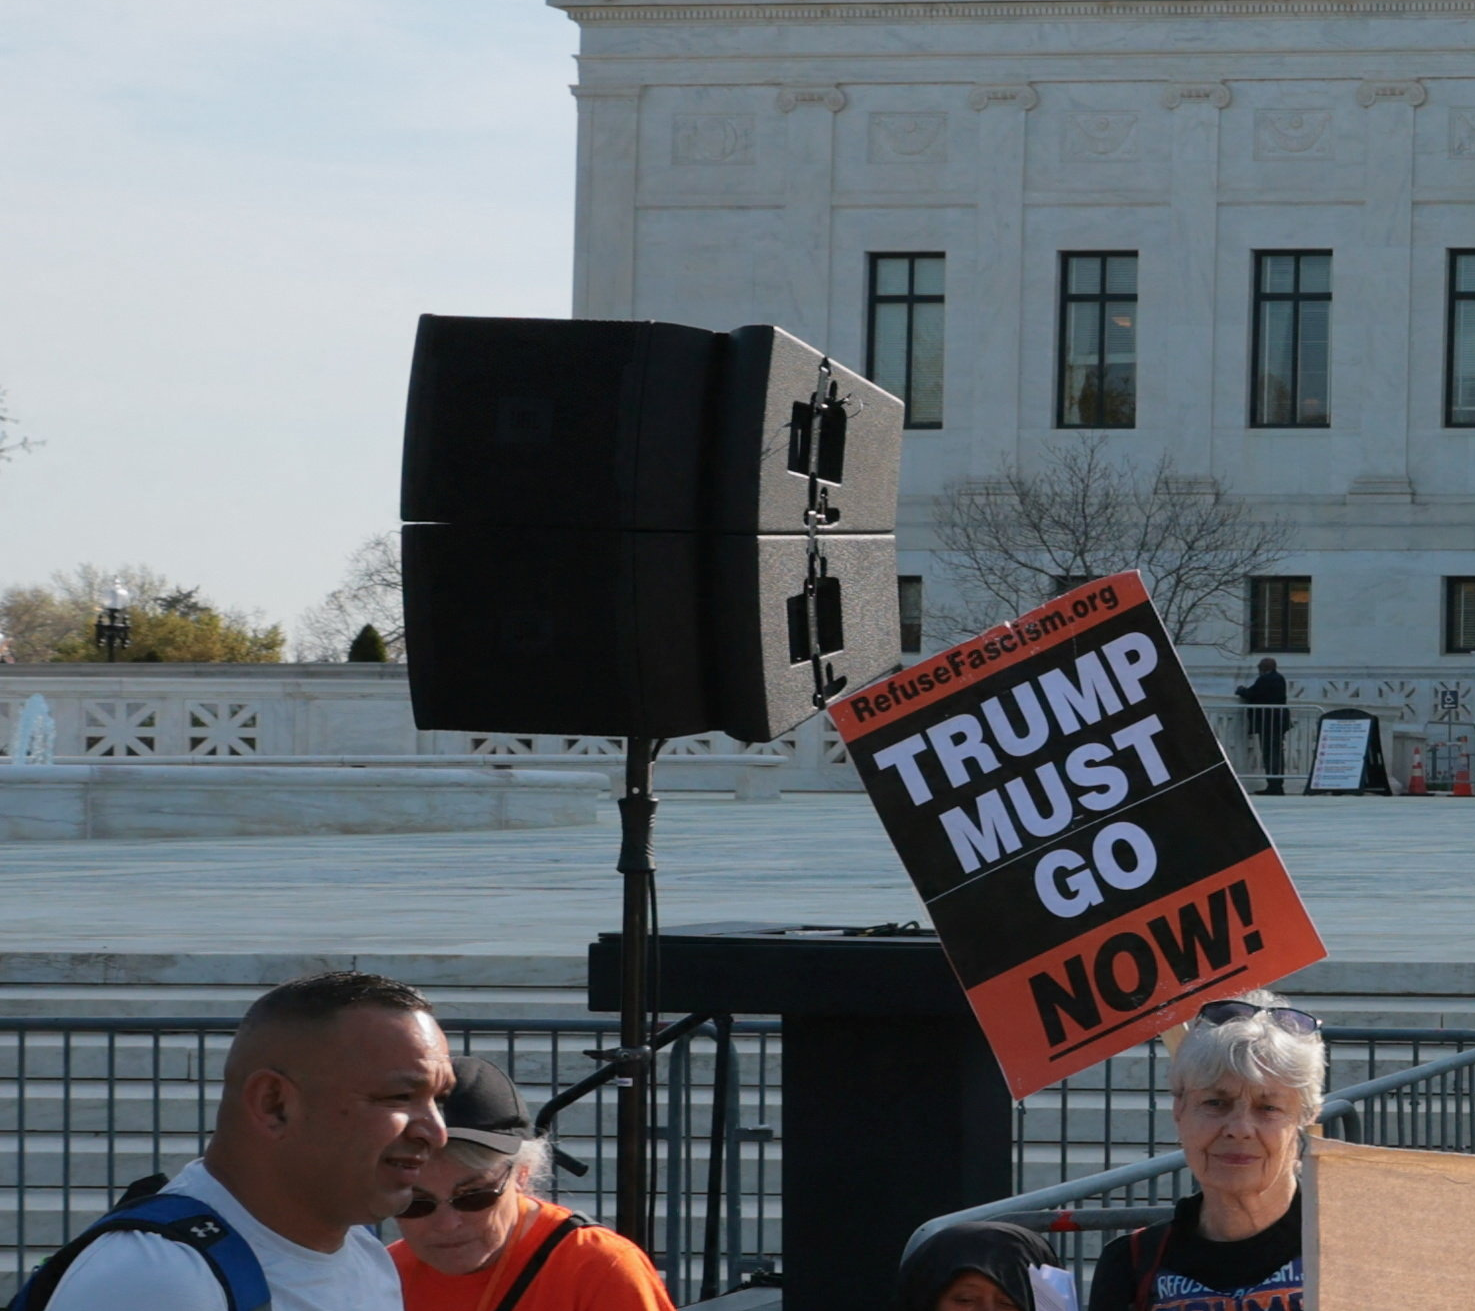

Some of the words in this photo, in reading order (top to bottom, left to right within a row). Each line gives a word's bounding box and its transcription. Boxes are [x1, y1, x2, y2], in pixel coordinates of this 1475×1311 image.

[850, 583, 1120, 724] RefuseFascism.org
[872, 631, 1159, 807] TRUMP
[938, 715, 1172, 875] MUST
[1034, 821, 1158, 919] GO
[1027, 880, 1264, 1048] NOW!
